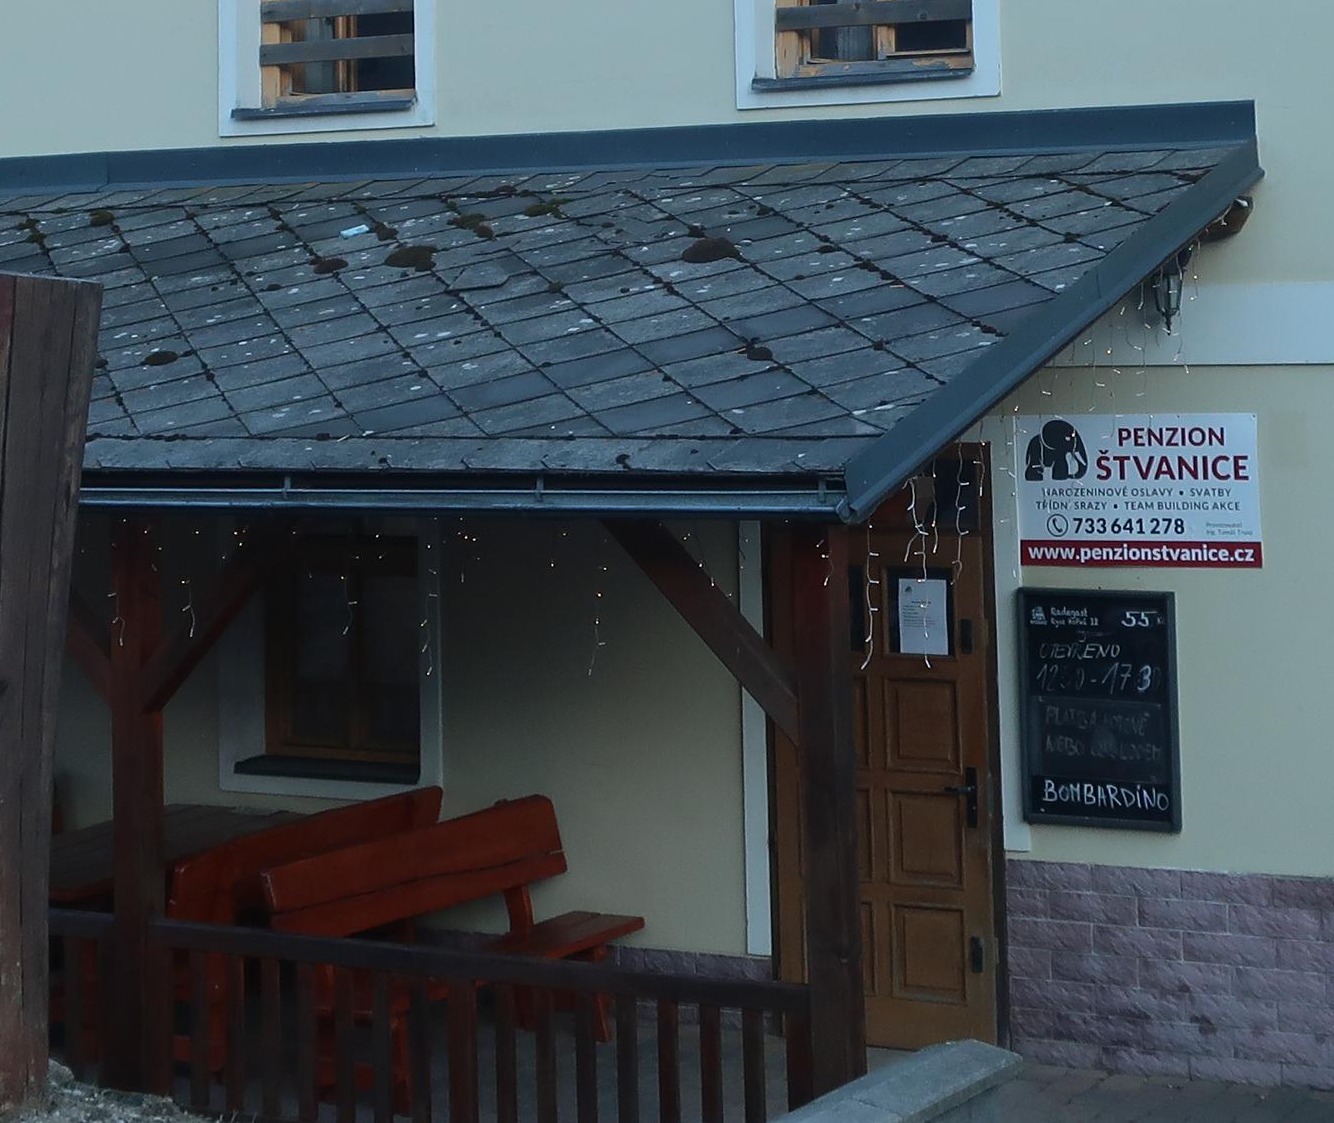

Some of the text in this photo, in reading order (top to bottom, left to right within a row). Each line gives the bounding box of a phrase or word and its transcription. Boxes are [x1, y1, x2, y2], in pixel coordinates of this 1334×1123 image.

[1117, 427, 1225, 447] PENZION
[1095, 449, 1250, 481] ŠTVANICE
[1130, 487, 1173, 497] OSLAVY
[1189, 487, 1232, 497] SVATBY
[1074, 501, 1107, 511] SRAZY
[1124, 501, 1154, 511] TEAM
[1157, 501, 1210, 511] BUILDING
[1212, 501, 1241, 511] AKCE
[1073, 518, 1185, 535] 733 641 278
[1028, 543, 1255, 563] www.penzionstvanice.cz
[1042, 779, 1170, 811] BOMBARDINO
